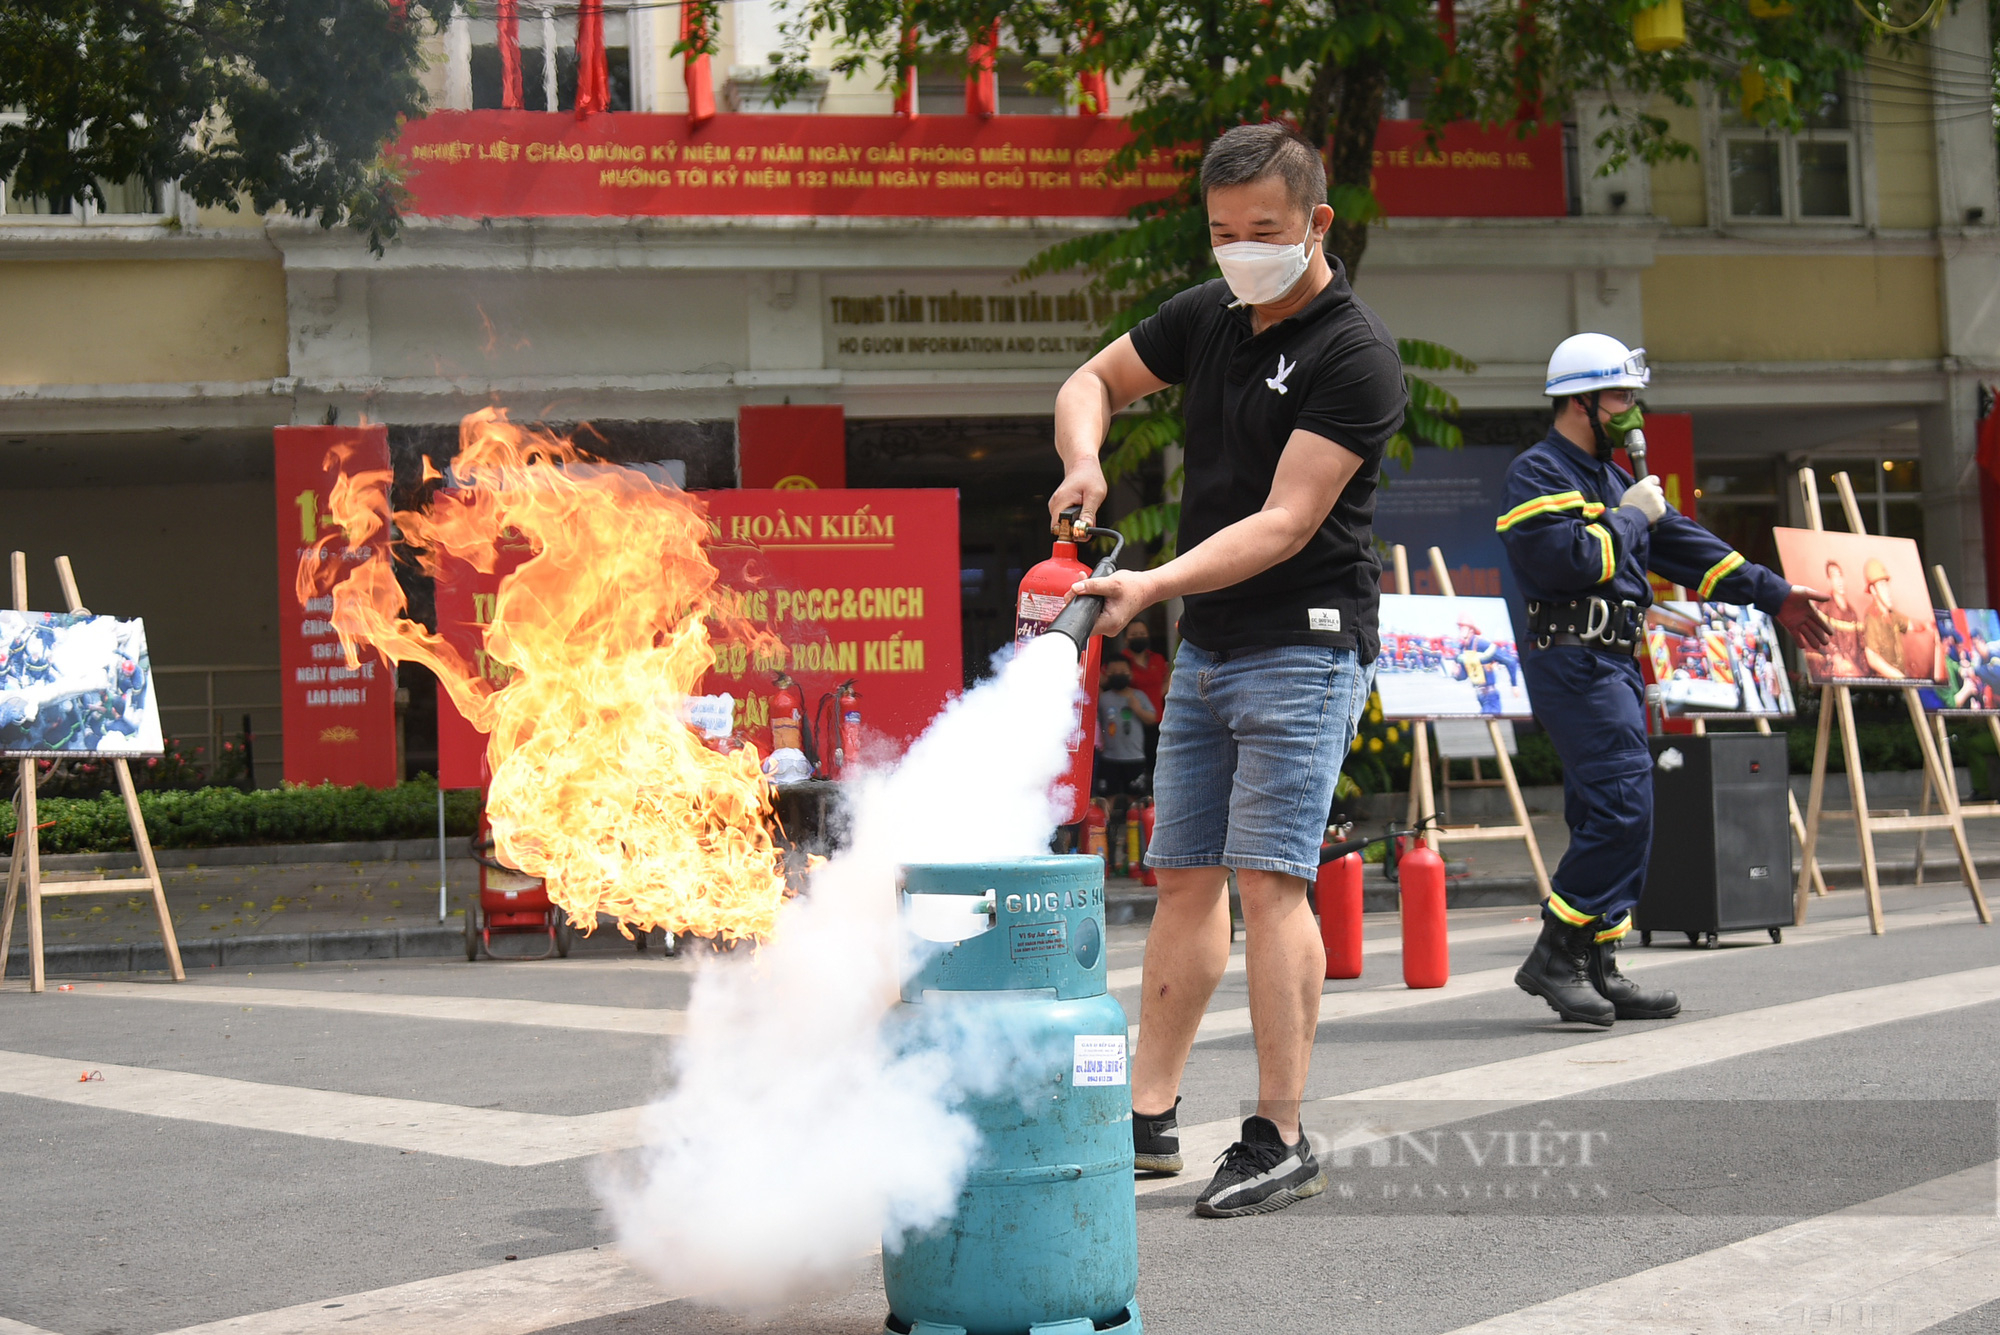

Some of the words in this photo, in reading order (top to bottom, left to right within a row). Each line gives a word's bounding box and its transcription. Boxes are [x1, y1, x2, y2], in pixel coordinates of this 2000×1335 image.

[526, 141, 585, 163] CHÀO
[588, 141, 646, 163] MỪNG
[651, 140, 678, 163] KỶ
[683, 142, 731, 165] NIỆM
[735, 146, 757, 163] 47
[761, 143, 803, 163] NĂM
[809, 143, 862, 163] NGÀY
[866, 142, 905, 164] GIẢI
[909, 144, 976, 164] PHÓNG
[980, 142, 1026, 164] MIỀN
[1030, 147, 1071, 164] NAM
[600, 165, 671, 188] HƯỚNG
[676, 166, 707, 187] TỚI
[712, 165, 739, 187] KỶ
[743, 167, 791, 190] NIỆM
[797, 171, 828, 188] 132
[832, 168, 874, 188] NĂM
[878, 168, 931, 188] NGÀY
[935, 170, 980, 188] SINH
[984, 166, 1024, 188] CHỦ
[1029, 171, 1071, 190] TỊCH
[908, 336, 1003, 353] INFORMATION
[1006, 336, 1035, 353] AND
[731, 508, 813, 539] HOÀN
[820, 504, 895, 538] KIẾM
[776, 587, 924, 622] PCCC&CNCH
[791, 634, 858, 672] HOÀN
[864, 630, 924, 671] KIẾM
